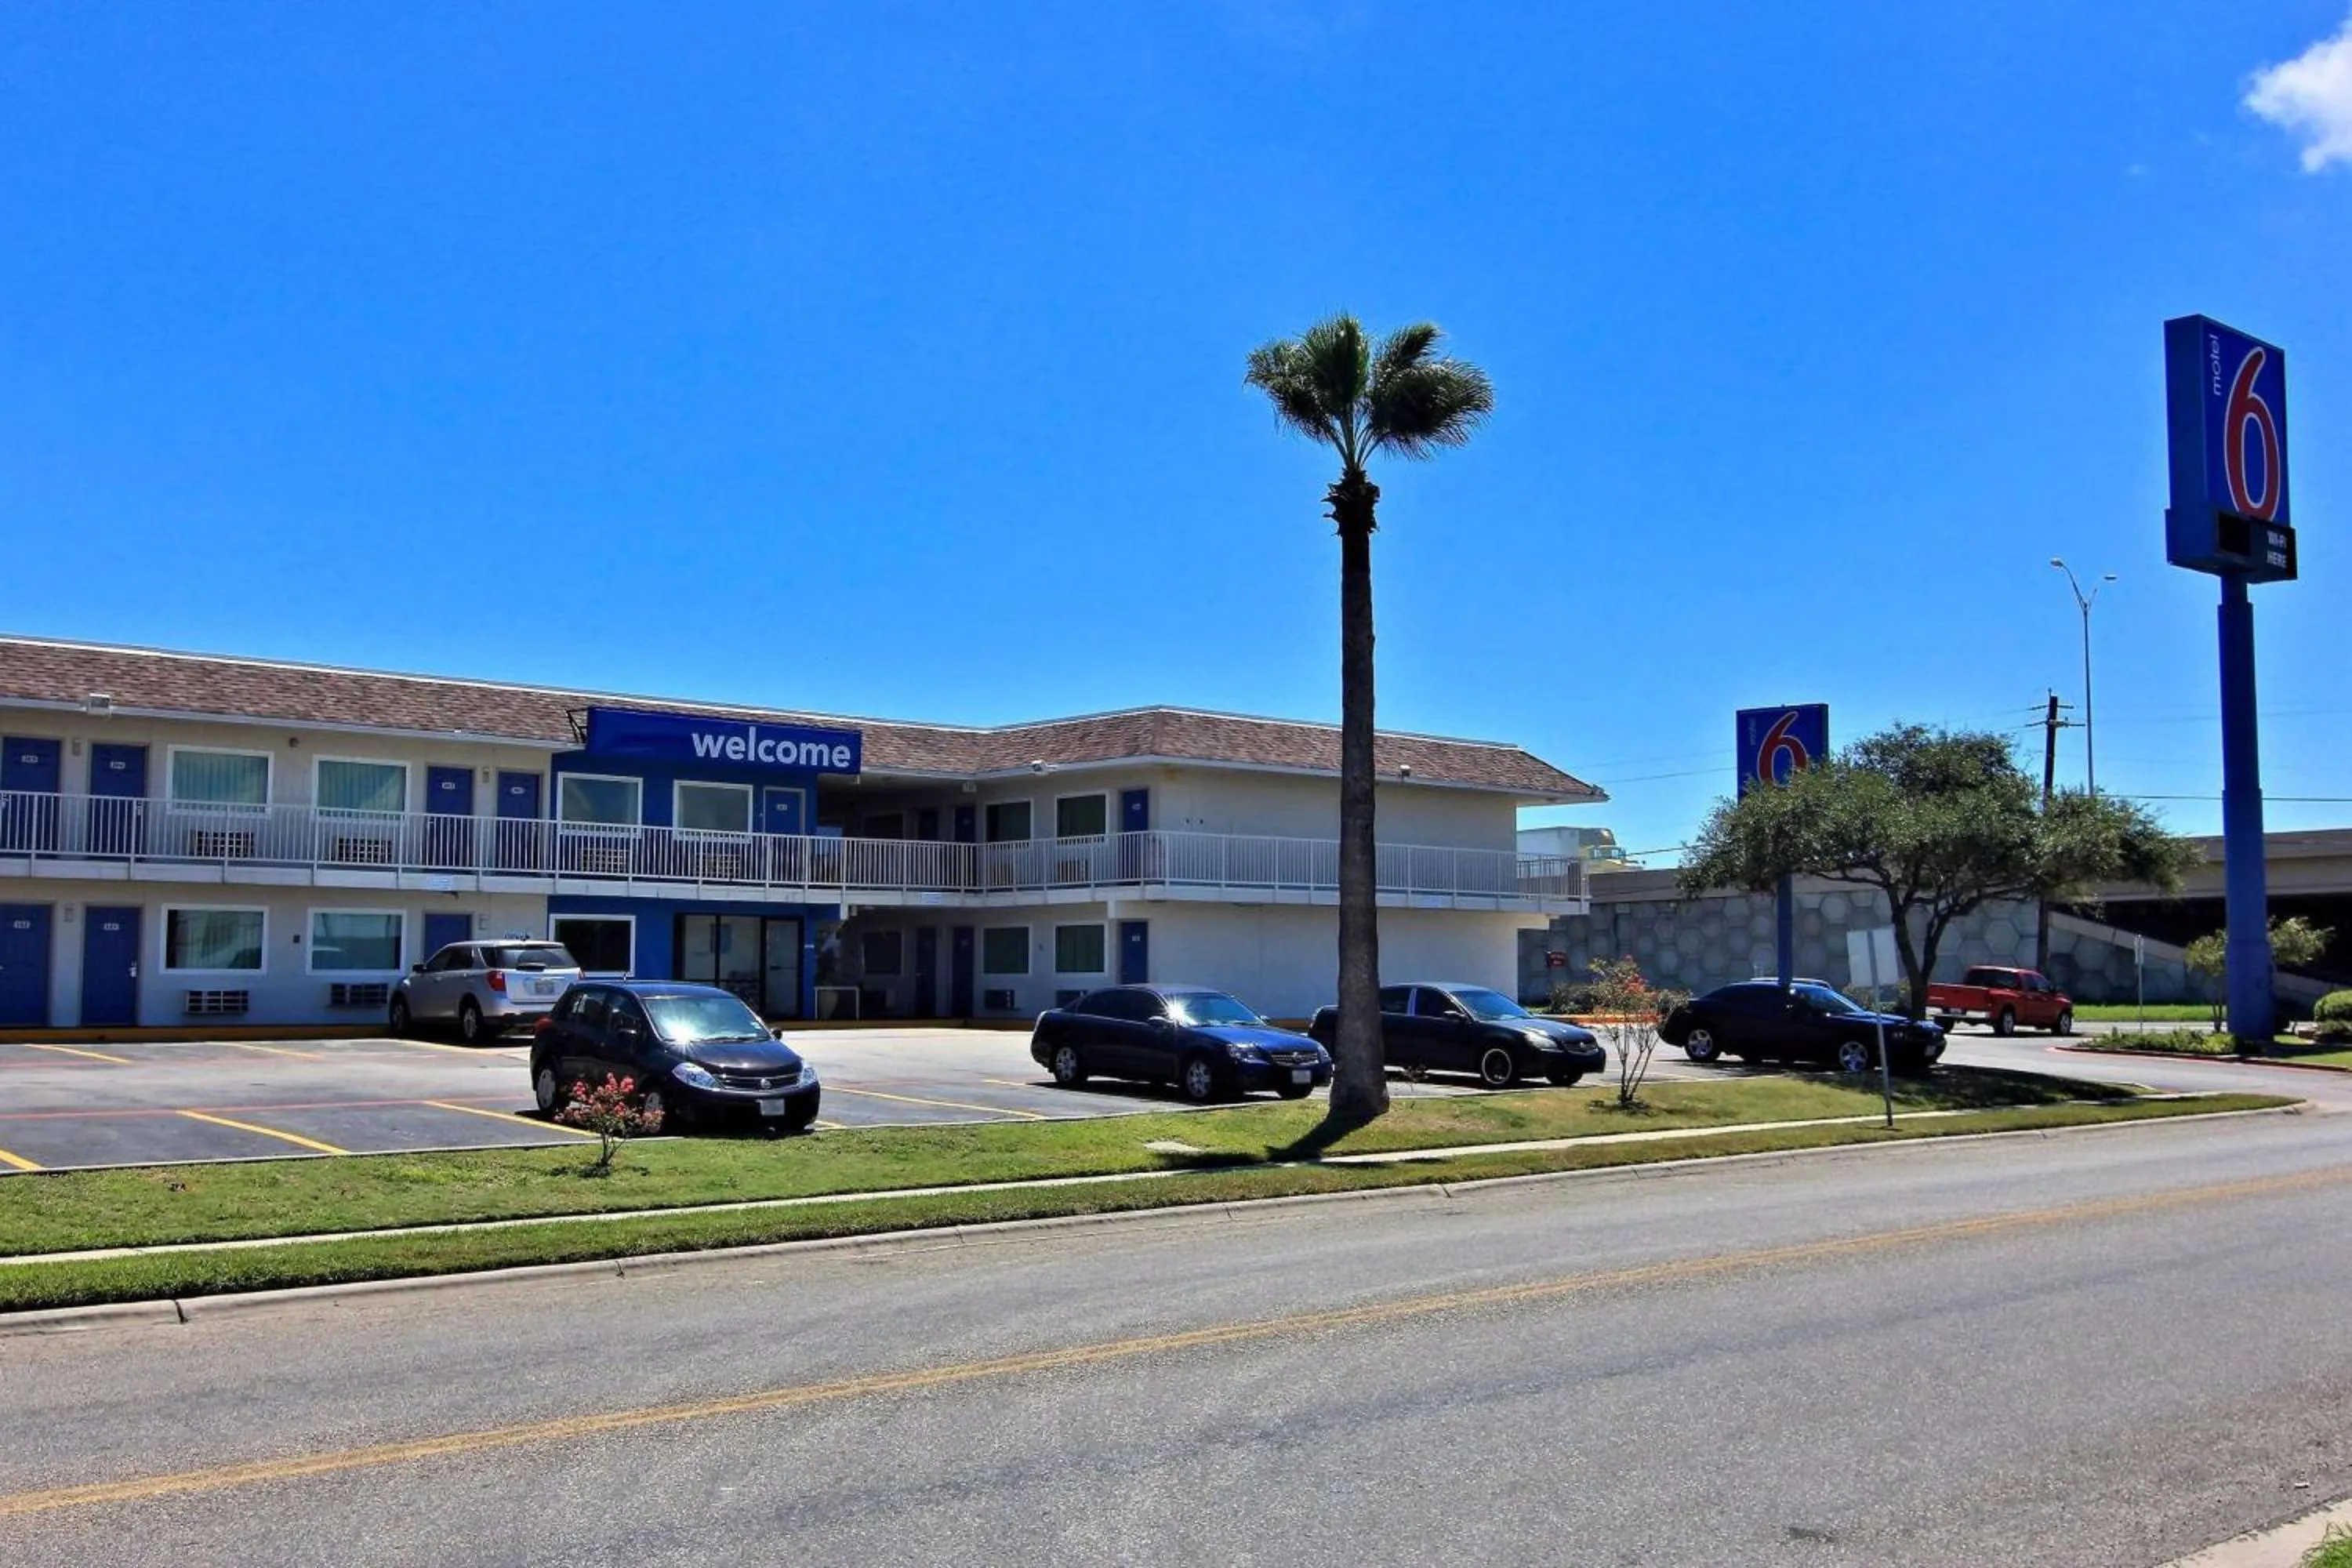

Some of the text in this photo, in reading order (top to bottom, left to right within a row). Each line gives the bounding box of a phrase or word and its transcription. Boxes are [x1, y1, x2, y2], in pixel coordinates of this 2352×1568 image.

[2209, 333, 2281, 521] motel 6
[2266, 550, 2288, 568] HERE
[691, 726, 851, 768] welcome
[1757, 710, 1808, 790] 6
